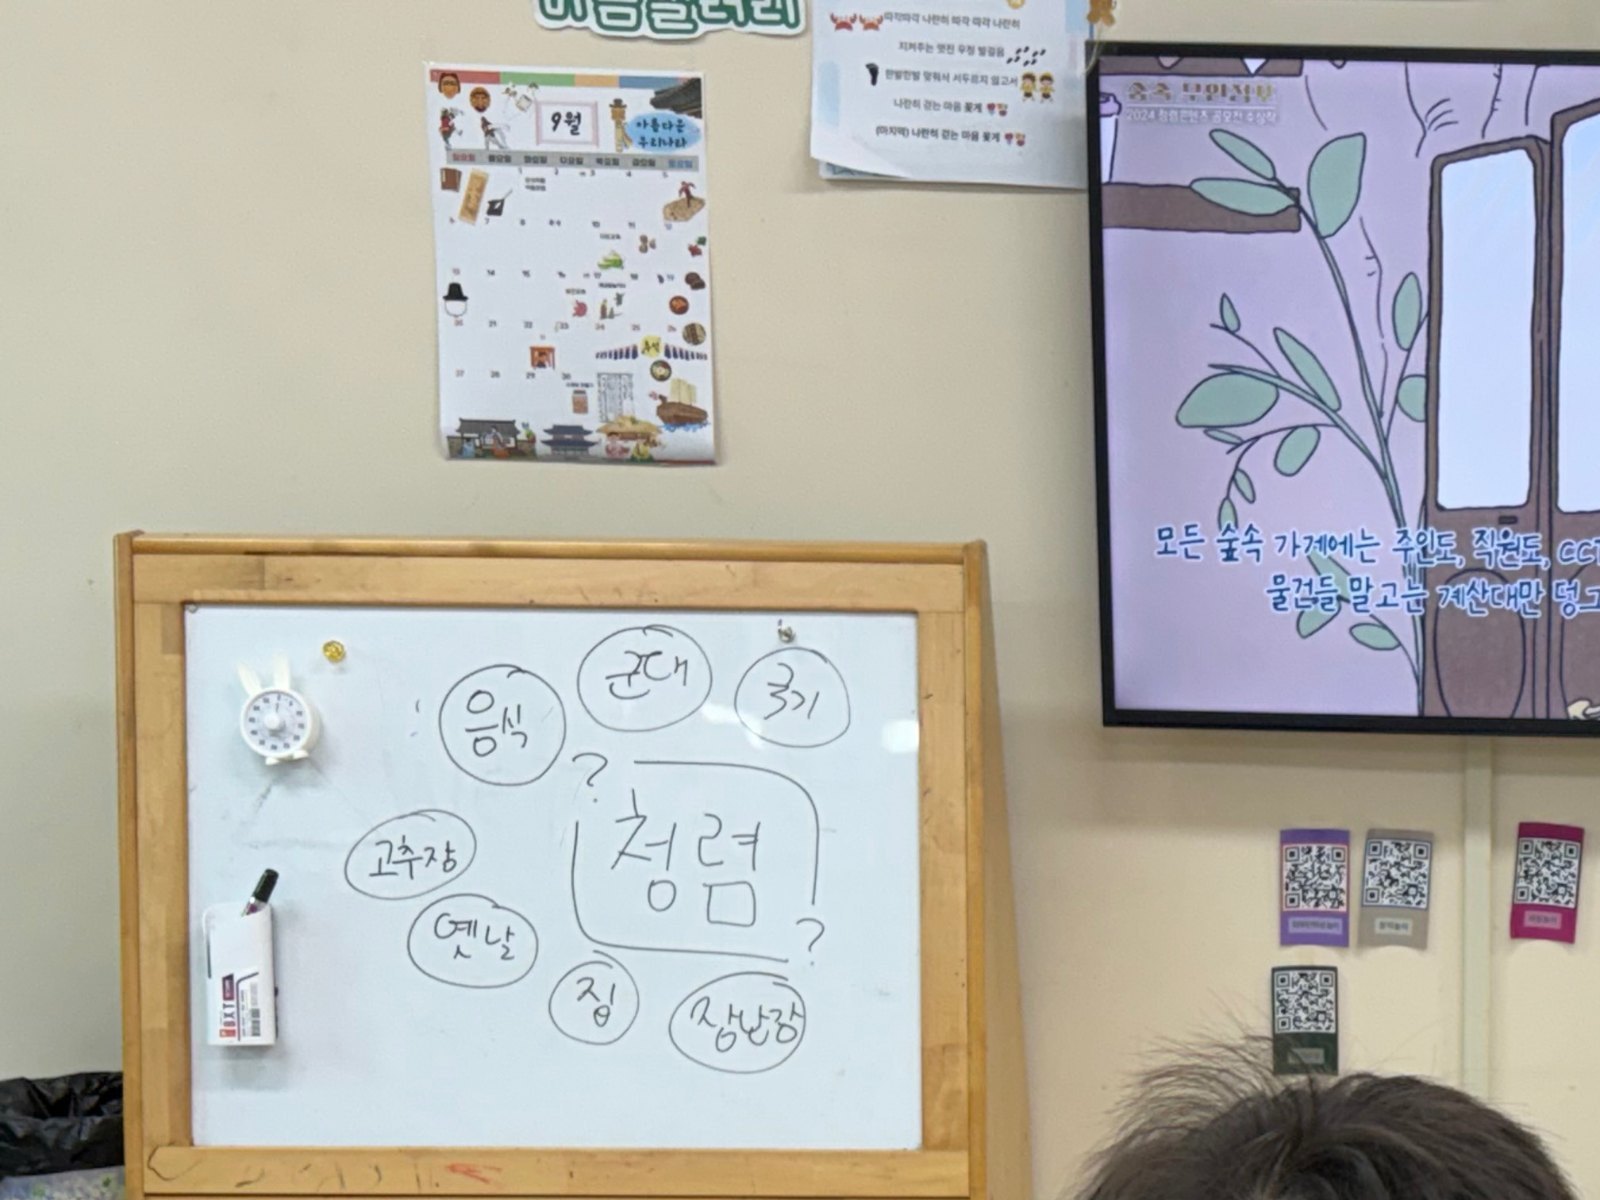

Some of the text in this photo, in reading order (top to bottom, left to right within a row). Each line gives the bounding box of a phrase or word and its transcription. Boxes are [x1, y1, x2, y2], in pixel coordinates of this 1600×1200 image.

[922, 14, 949, 26] 나란히
[952, 16, 970, 27] 따각
[973, 17, 991, 28] 따각
[992, 17, 1021, 29] 나란히
[958, 45, 975, 57] 우정
[953, 72, 988, 85] 서두르지
[894, 99, 921, 111] 나란히
[943, 101, 961, 112] 마음
[1126, 108, 1154, 121] 2024
[550, 111, 582, 136] 9월
[636, 117, 686, 132] 아름다운
[911, 127, 939, 139] 나란히
[962, 130, 980, 142] 마음
[638, 136, 687, 149] 우리나라
[1154, 528, 1206, 558] 모든
[1216, 525, 1264, 565] 숲속
[1272, 529, 1382, 567] 가게에는
[1391, 528, 1465, 569] 주인도,
[1471, 529, 1551, 571] 직원도,
[1264, 574, 1340, 614] 물건들
[1347, 575, 1428, 614] 말고는
[1437, 579, 1546, 615] 계산대만
[605, 650, 688, 700] 군대
[465, 689, 528, 758] 음식
[369, 834, 458, 880] 고추장
[610, 787, 763, 928] 청렴
[433, 912, 516, 961] 옛날
[576, 975, 617, 1028] 집
